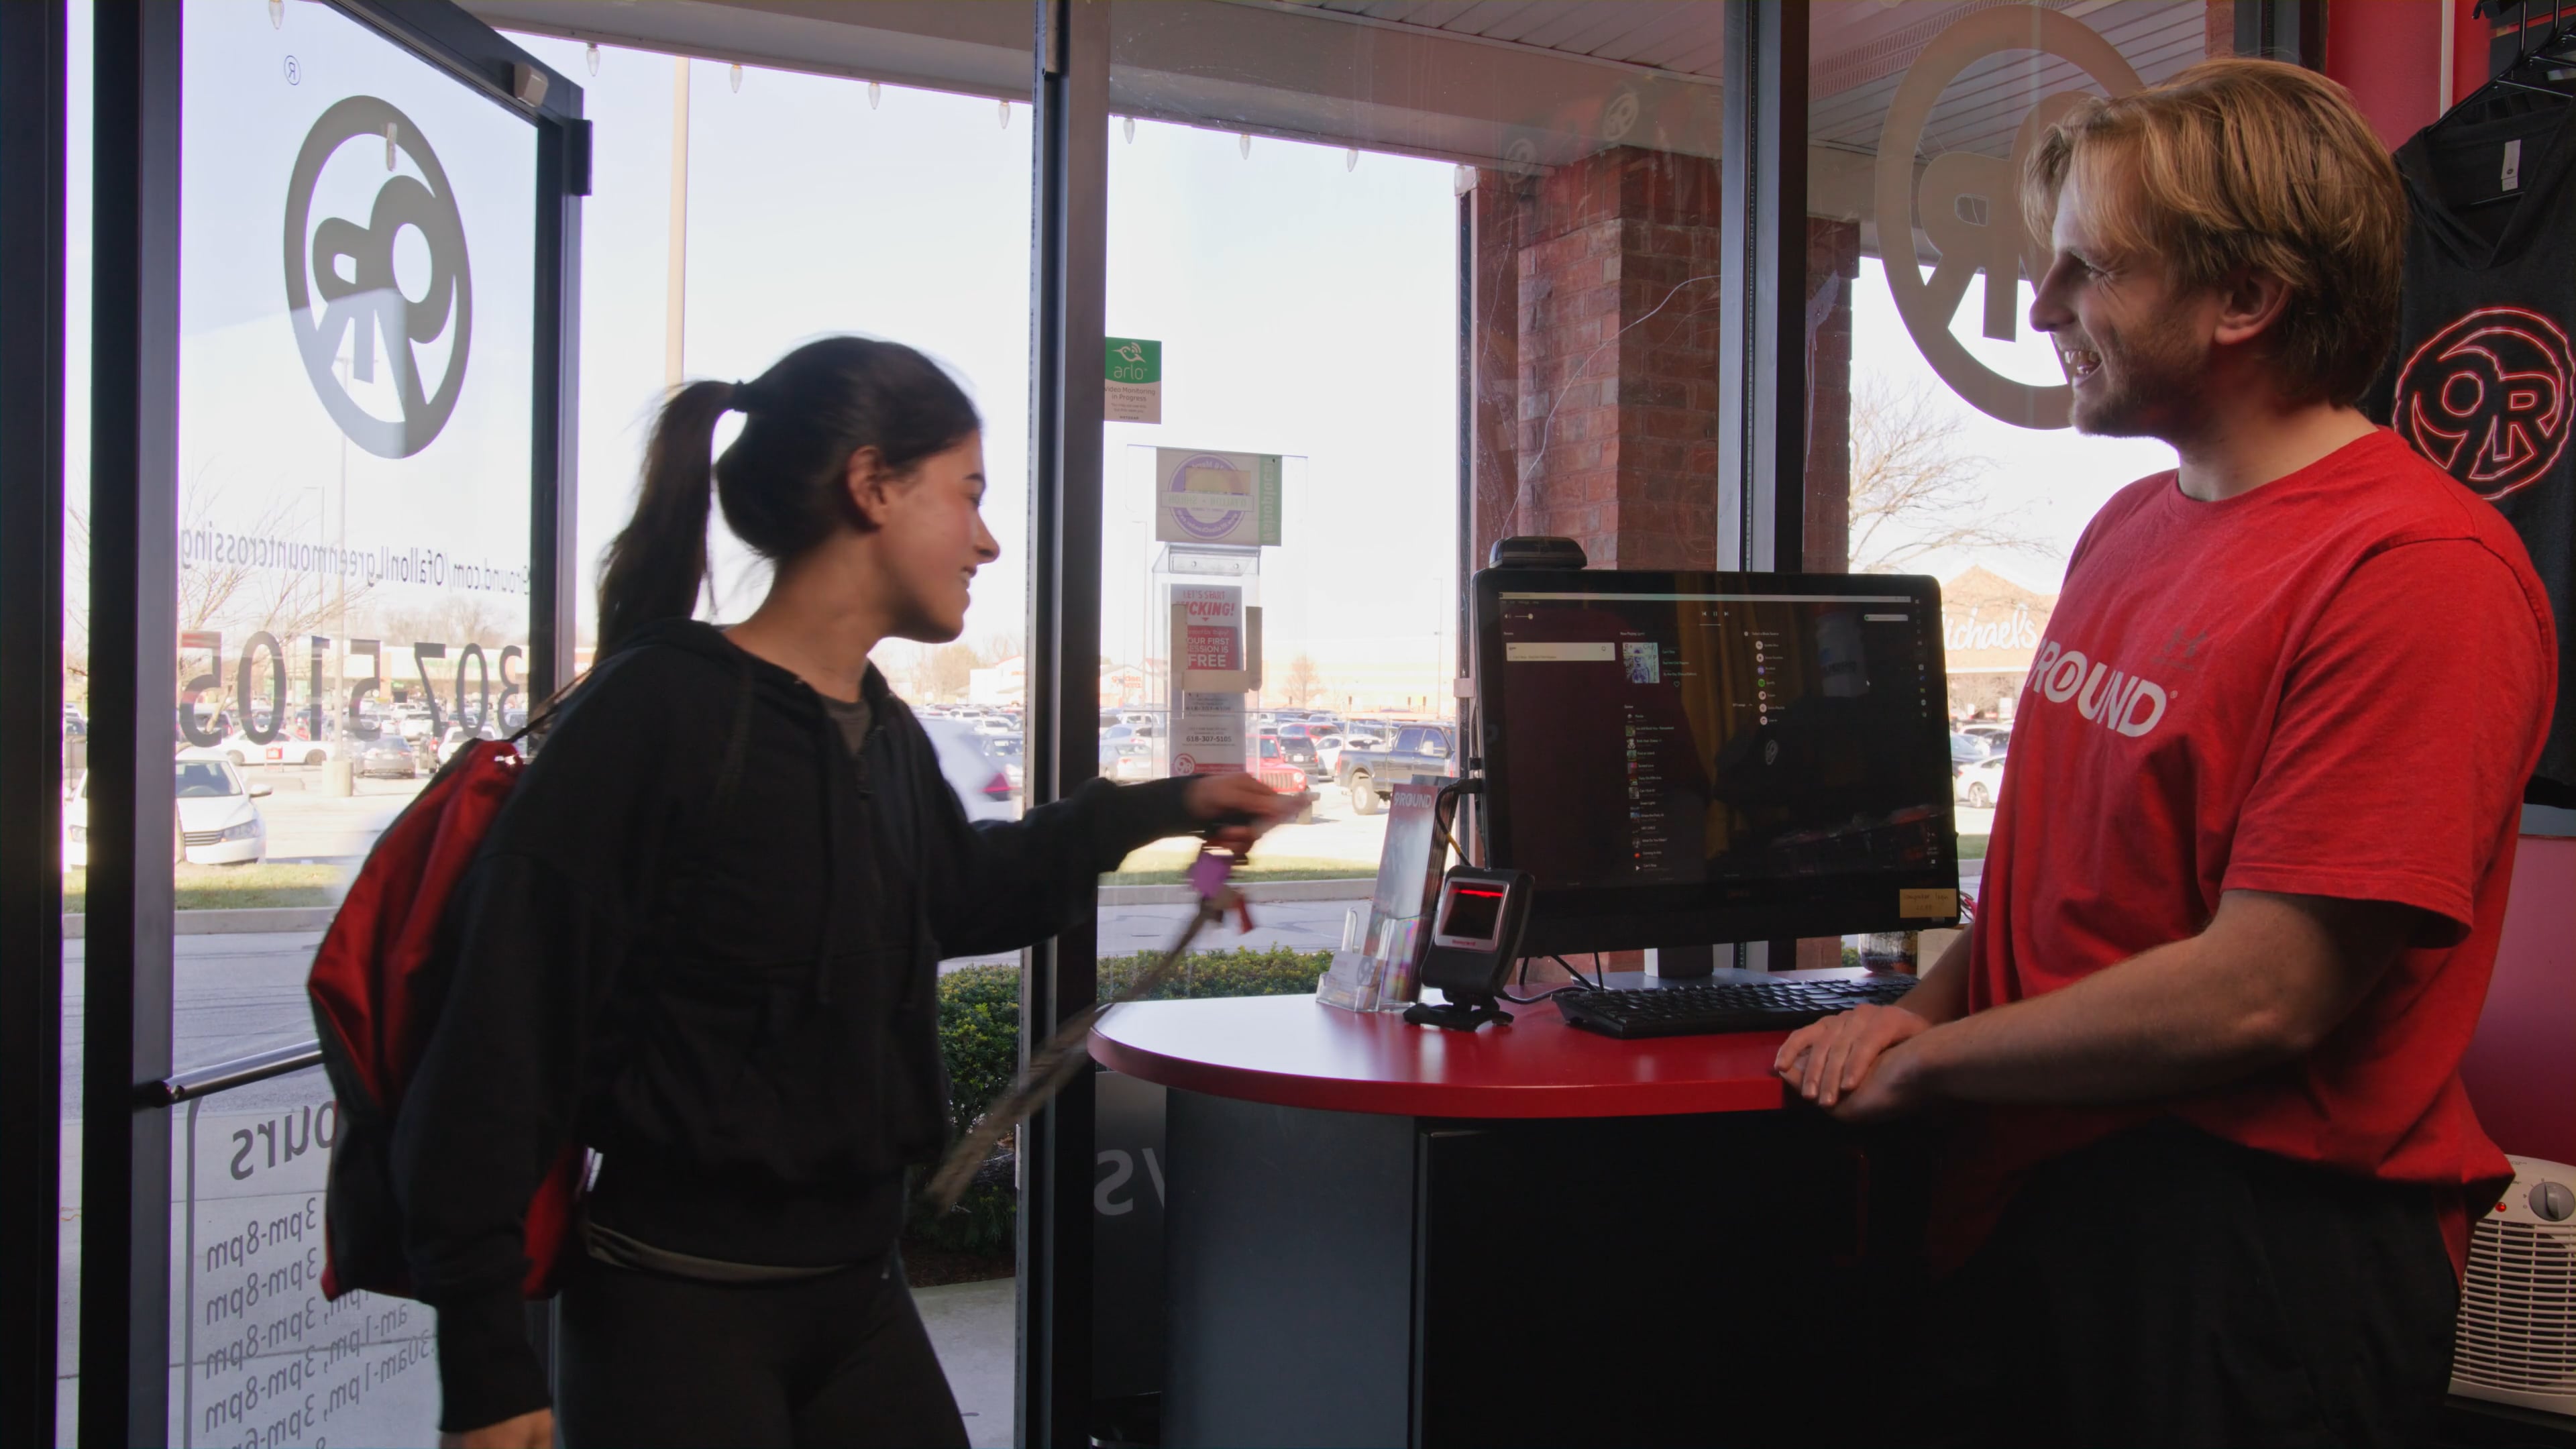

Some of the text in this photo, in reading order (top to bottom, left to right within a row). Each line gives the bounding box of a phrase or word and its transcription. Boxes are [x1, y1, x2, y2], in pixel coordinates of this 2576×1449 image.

[1114, 364, 1144, 380] arlo
[1119, 394, 1147, 402] Progress
[1122, 387, 1155, 395] Monitoring
[1183, 590, 1225, 600] LET'S START
[1177, 601, 1234, 616] CKING!
[1188, 653, 1226, 667] FREE
[2026, 637, 2167, 737] ROUND
[1394, 793, 1432, 808] 9ROUND
